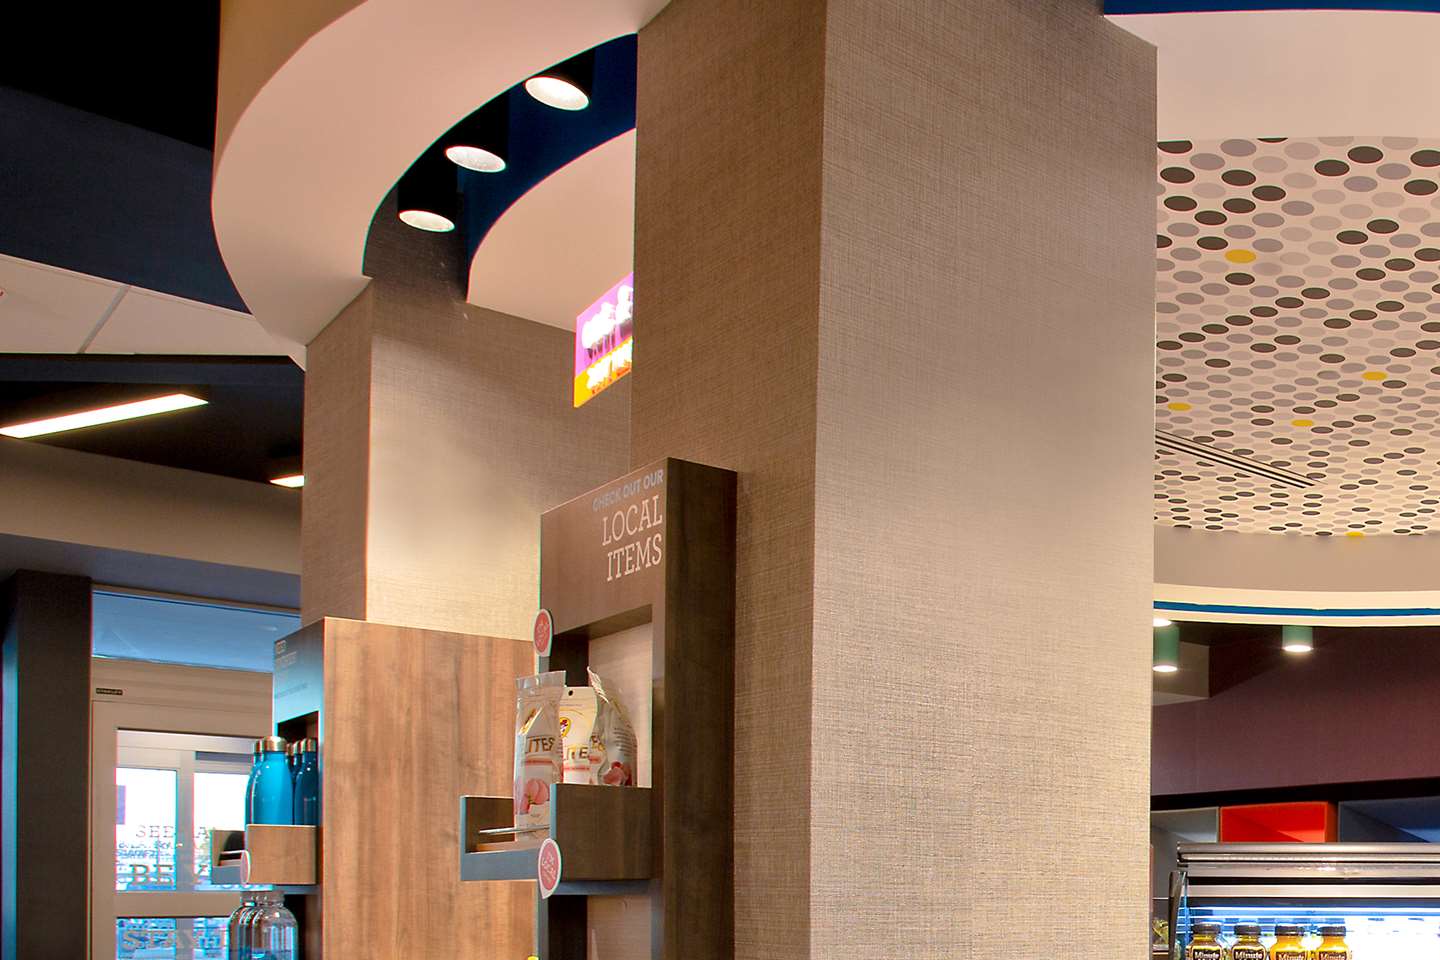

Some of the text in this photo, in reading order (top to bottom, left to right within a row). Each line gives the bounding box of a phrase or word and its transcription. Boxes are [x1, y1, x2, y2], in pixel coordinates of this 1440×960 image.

[623, 479, 641, 498] OUT
[643, 468, 664, 490] OUR
[602, 495, 662, 546] LOCAL
[607, 533, 662, 582] ITEMS
[1194, 950, 1219, 958] Minute
[1235, 950, 1262, 958] Minute
[1278, 953, 1304, 960] Minute
[1320, 952, 1345, 960] Minute
